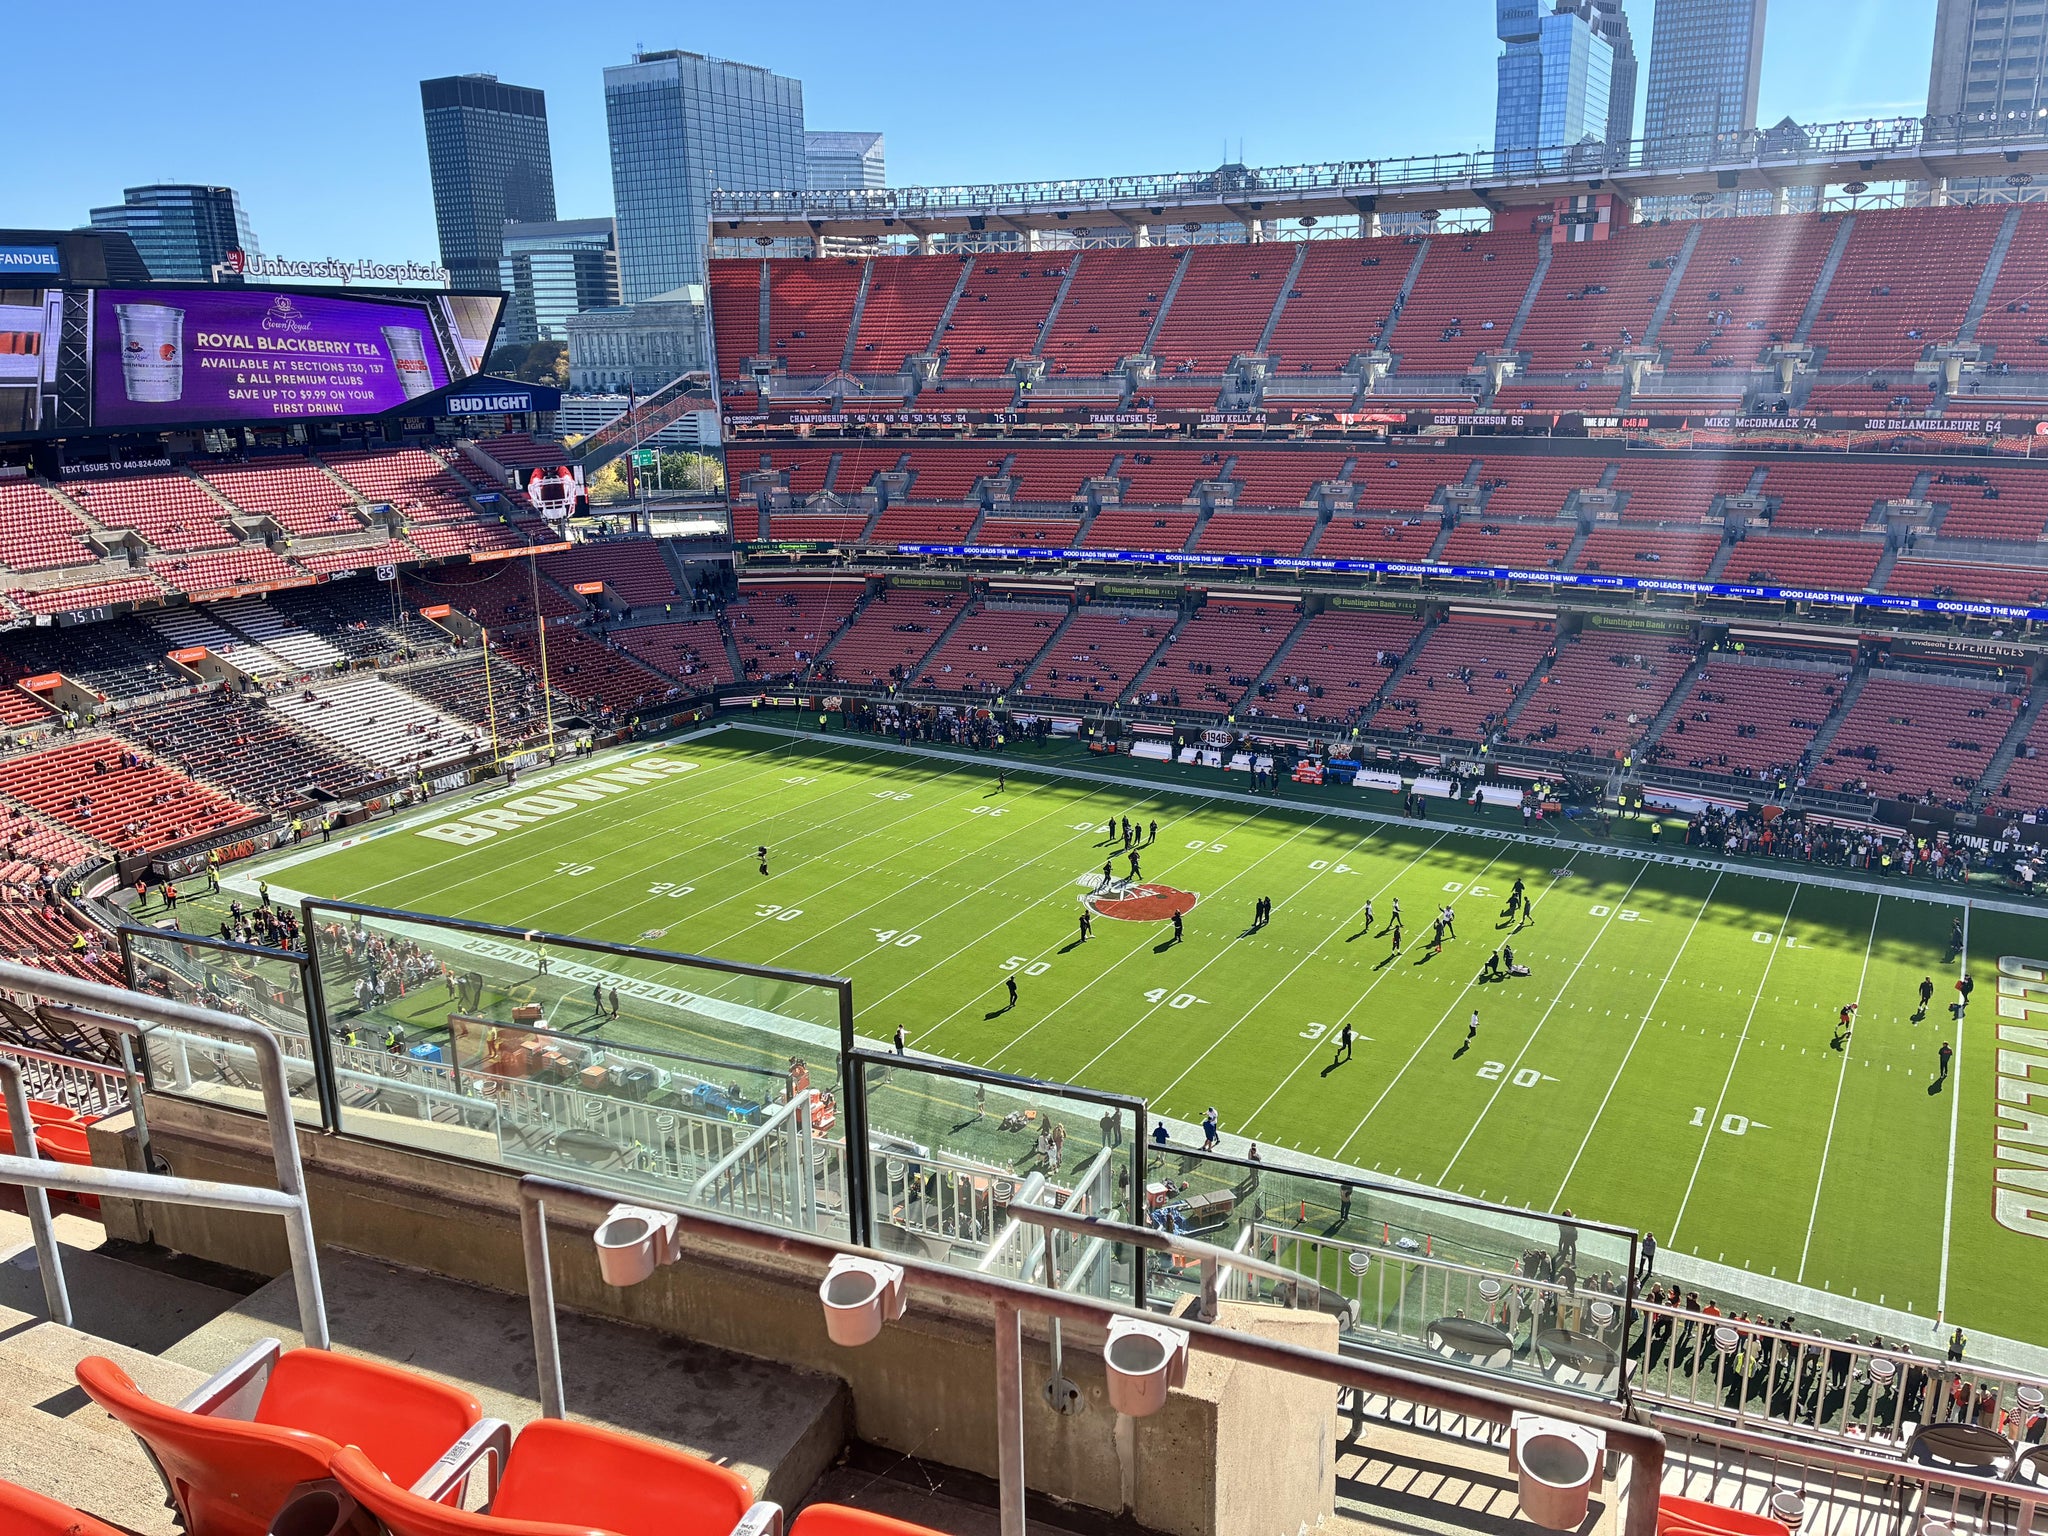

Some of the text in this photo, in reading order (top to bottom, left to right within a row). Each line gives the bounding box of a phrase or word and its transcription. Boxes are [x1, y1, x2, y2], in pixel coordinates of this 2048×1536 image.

[1502, 9, 1534, 19] Hilton
[0, 254, 58, 265] FANDUEL
[246, 254, 447, 284] University Hospitals
[262, 318, 287, 332] Crown
[197, 333, 380, 356] ROYAL BLACKBERRY TEA
[201, 358, 384, 374] AVAILABLE AT SECTIONS 130, 137
[237, 374, 363, 386] & ALL PREMIUM CLUBS
[228, 389, 374, 400] SAVE UP TO $9.99 ON YOUR
[273, 403, 344, 413] FIRST DRINK!
[450, 396, 528, 412] BUD LIGHT
[790, 415, 848, 423] CHAMPIONSHIPS
[1090, 414, 1158, 423] FRANK GATSKI 52
[1200, 414, 1266, 423] LEROY KELLY 44
[1434, 416, 1524, 426] GENE HICKERSON 66
[1583, 418, 1618, 428] TIME OF DAY
[1637, 419, 1648, 428] AM
[1704, 418, 1730, 427] MIKE
[1804, 418, 1817, 429] 74
[1865, 420, 1885, 429] JOE
[1986, 421, 2001, 432] 64
[61, 465, 82, 474] TEXT
[83, 464, 108, 472] ISSUES
[1166, 554, 1182, 562] GOOD
[1210, 556, 1225, 564] WAY
[1274, 558, 1336, 568] GOOD LEADS THE WAY
[380, 567, 393, 579] 25
[1388, 564, 1454, 575] GOOD LEADS THE WAY
[1508, 571, 1578, 583] GOOD LEADS THE WAY
[1593, 577, 1616, 585] UNITED
[1110, 585, 1142, 595] Huntington
[1638, 579, 1714, 593] GOOD LEADS THE WAY
[1730, 587, 1755, 595] UNITED
[1342, 598, 1378, 608] Huntington
[1379, 600, 1396, 608] Bank
[1780, 589, 1864, 604] GOOD LEADS THE WAY
[1882, 598, 1910, 607] UNITED
[69, 608, 104, 623] 75:17
[1937, 601, 2030, 618] GOOD LEADS THE WAY
[1603, 616, 1644, 628] Huntington
[1646, 620, 1665, 630] Bank
[1911, 640, 1946, 648] vividseats
[1207, 732, 1226, 744] 1946
[414, 757, 702, 846] BROWNS
[971, 805, 1010, 818] 30
[1185, 839, 1228, 854] 50
[1453, 826, 1723, 870] INTERCEPT CANCER
[1993, 840, 2010, 853] OF
[554, 862, 595, 876] 10
[1307, 859, 1352, 875] 40
[647, 882, 695, 898] 20
[1442, 881, 1489, 897] 30
[754, 904, 804, 922] 30
[1588, 905, 1641, 922] 20
[875, 929, 922, 947] 40
[1752, 931, 1798, 948] 10
[998, 955, 1052, 976] 50
[556, 964, 696, 1006] INTERCEPT
[1143, 987, 1197, 1010] 40
[1299, 1021, 1360, 1047] 30
[1476, 1061, 1542, 1088] 20
[1689, 1106, 1750, 1136] 10
